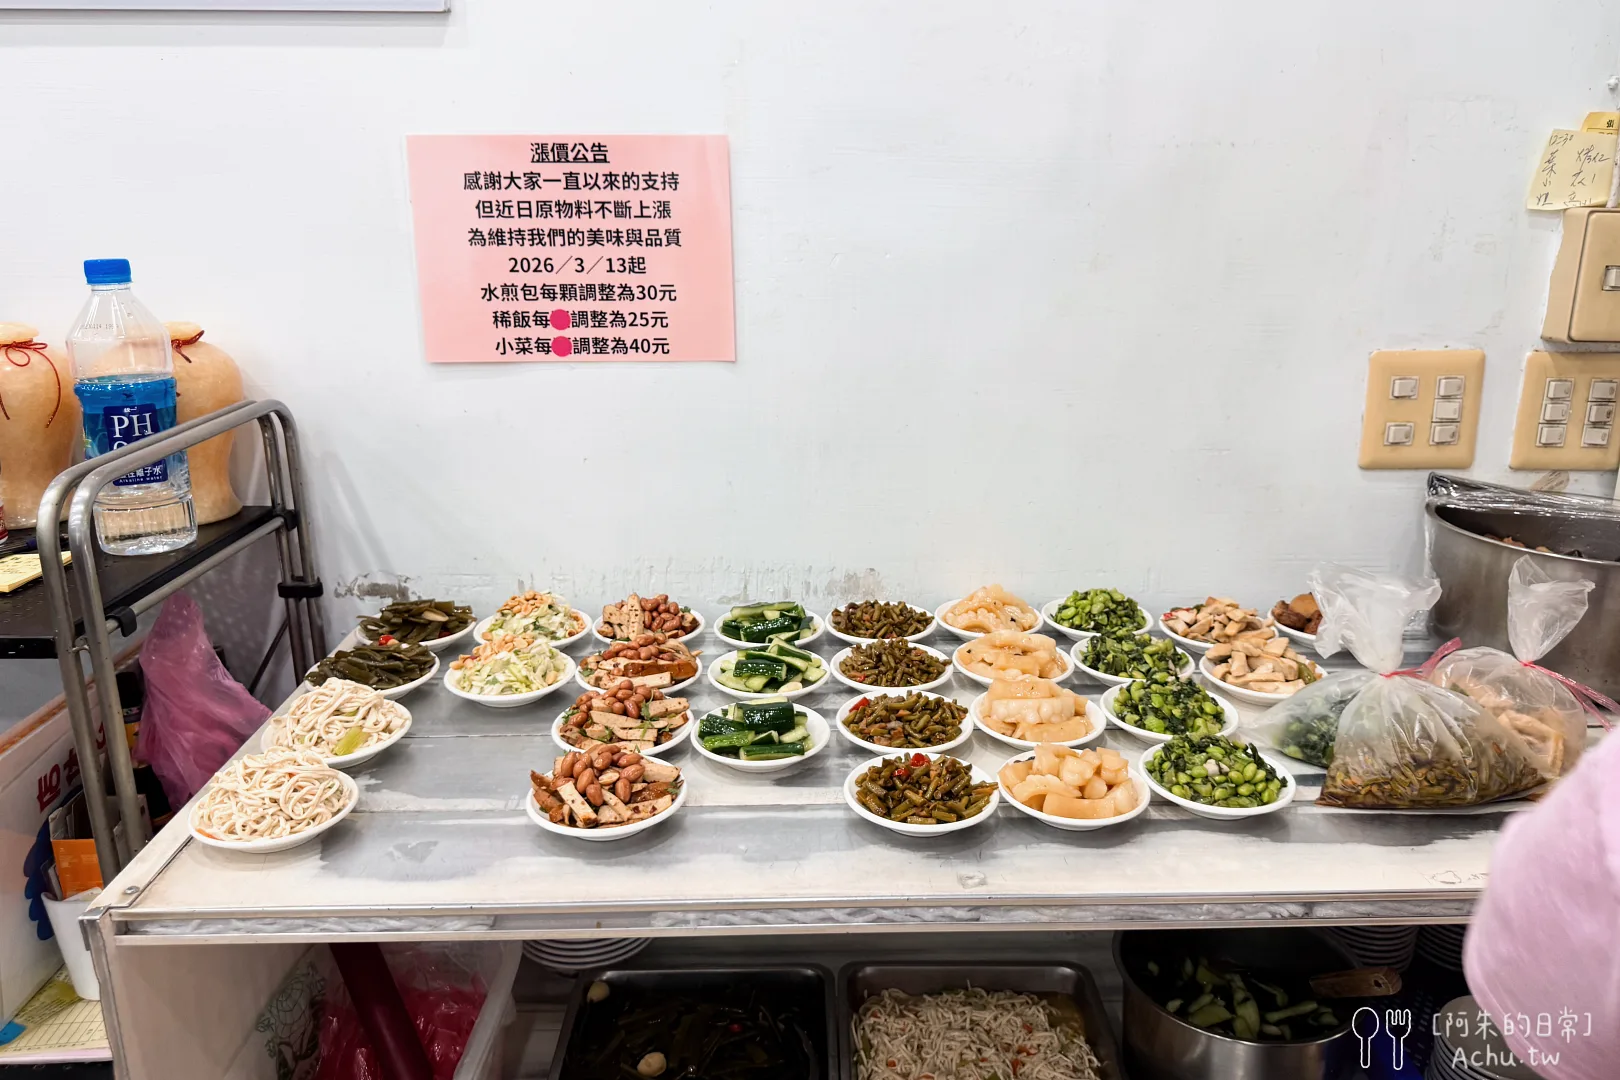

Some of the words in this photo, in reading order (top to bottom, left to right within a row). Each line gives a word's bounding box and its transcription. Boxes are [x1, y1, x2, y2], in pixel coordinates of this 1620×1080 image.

[530, 142, 610, 163] 漲價公告
[463, 170, 680, 191] 感謝大家一直以來的支持
[475, 199, 672, 219] 但近日原物料不斷上漲
[467, 227, 682, 248] 為維持我們的美味與品質
[480, 283, 677, 302] 水煎包每顆調整為30元
[492, 310, 669, 330] 稀飯每調整為25元
[495, 336, 670, 356] 小菜每調整為40元
[110, 412, 155, 438] PH
